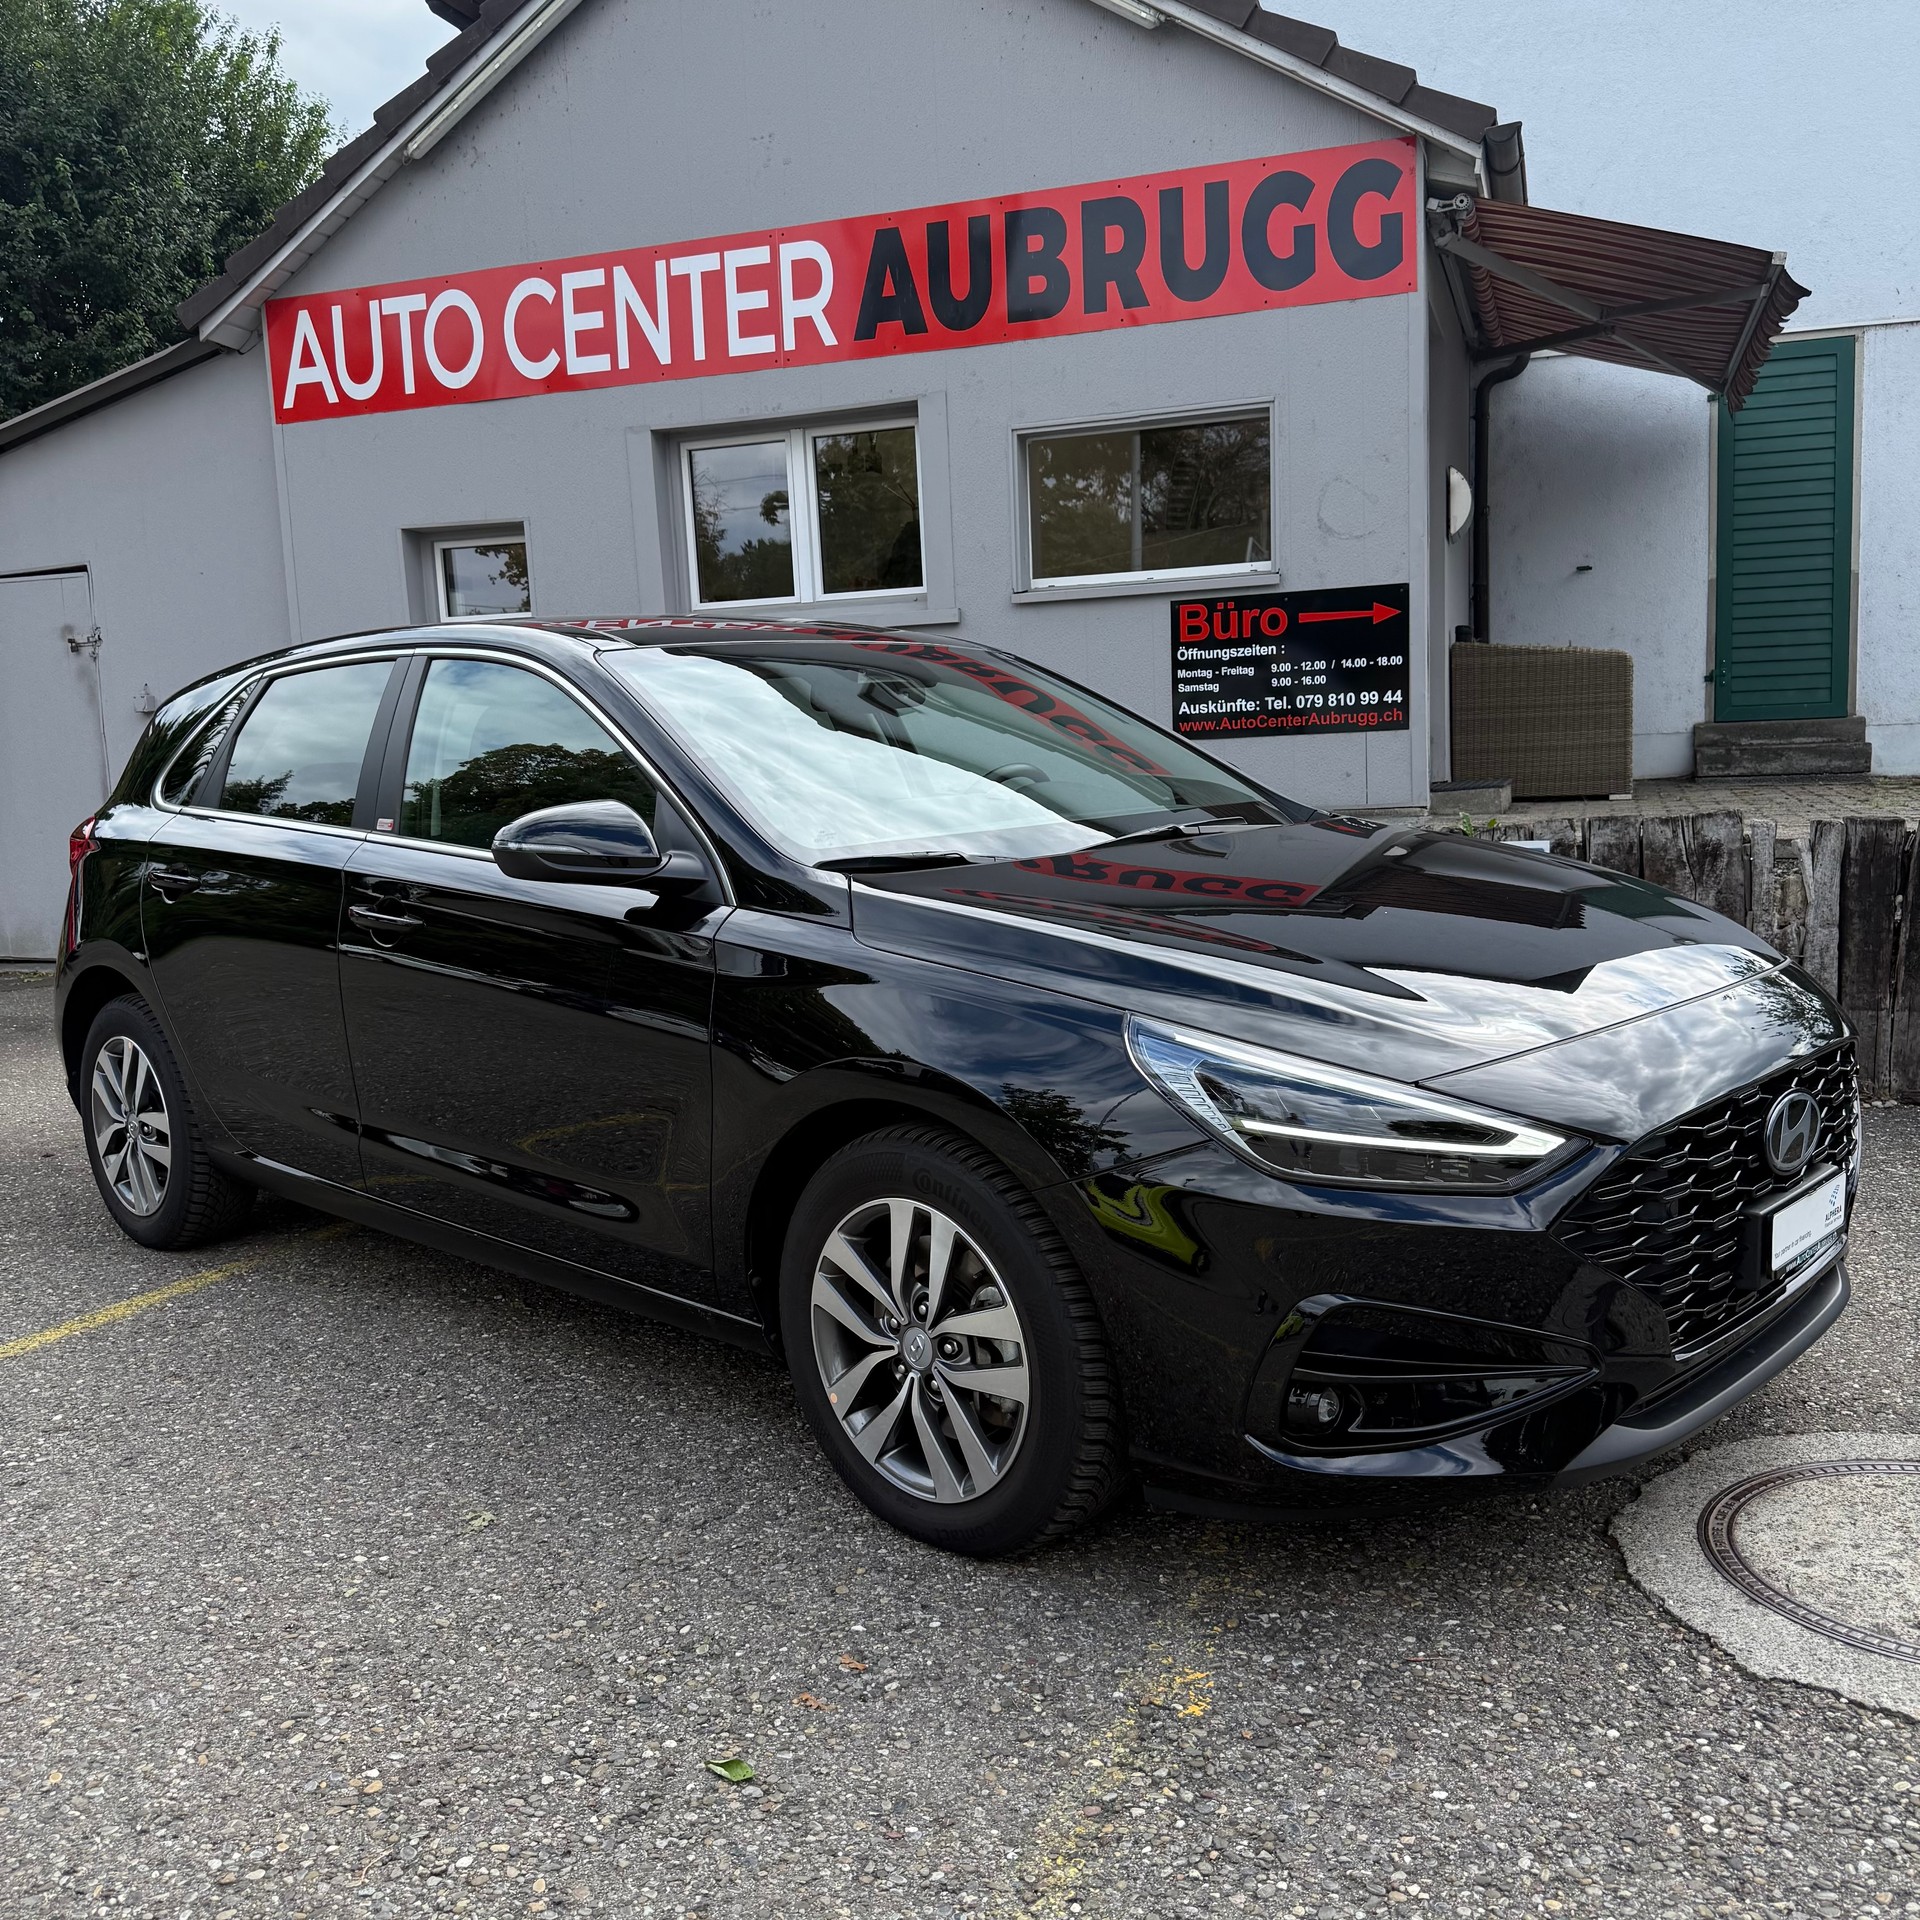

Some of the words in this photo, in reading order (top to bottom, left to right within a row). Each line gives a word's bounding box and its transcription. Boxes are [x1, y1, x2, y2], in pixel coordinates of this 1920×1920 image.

[283, 288, 484, 409] AUTO
[503, 240, 838, 380] CENTER
[853, 158, 1404, 341] AUBRUGG
[1180, 602, 1288, 642] Büro
[1177, 644, 1276, 661] Öffnungszeiten
[1178, 669, 1212, 679] Montag
[1222, 666, 1254, 677] Freitag
[1271, 663, 1291, 673] 9.00
[1301, 661, 1326, 671] 12.00
[1341, 658, 1366, 668] 14.00
[1377, 656, 1403, 666] 18.00
[1178, 683, 1219, 693] Samstag
[1272, 677, 1291, 687] 9.00
[1301, 675, 1326, 685] 16.00
[1179, 699, 1260, 715] Auskünfte:
[1265, 697, 1291, 710] Tel.
[1296, 695, 1323, 708] 079
[1328, 693, 1355, 706] 810
[1360, 691, 1378, 705] 99
[1383, 690, 1402, 704] 44
[1179, 708, 1402, 732] www.AutoCenterAubrugg.ch
